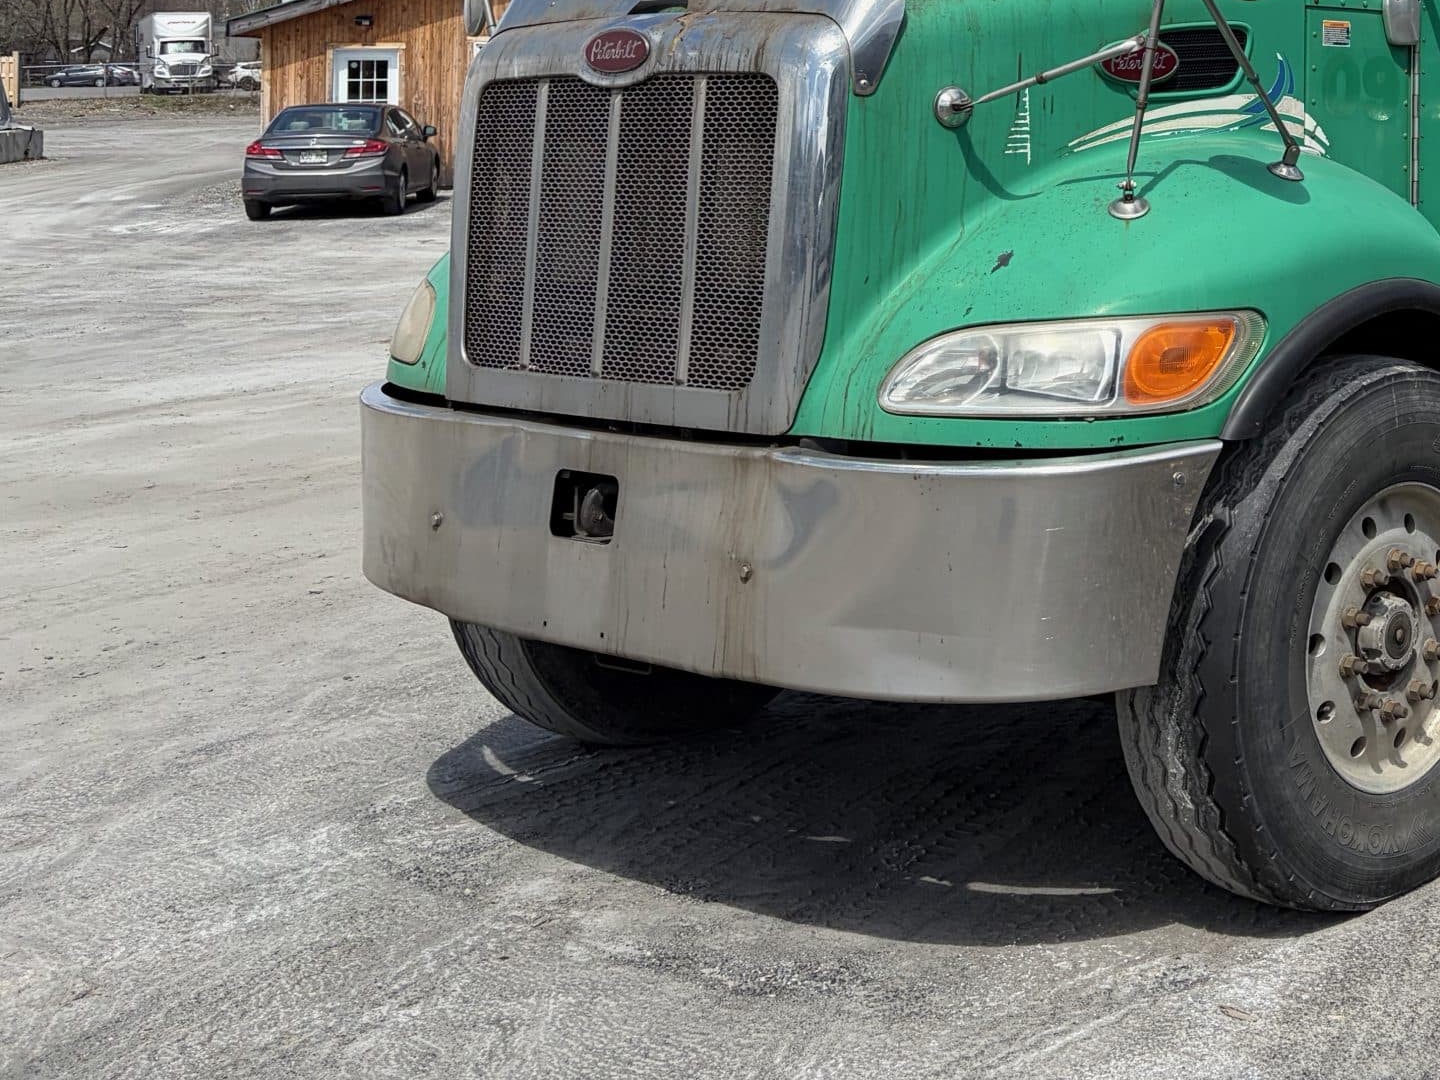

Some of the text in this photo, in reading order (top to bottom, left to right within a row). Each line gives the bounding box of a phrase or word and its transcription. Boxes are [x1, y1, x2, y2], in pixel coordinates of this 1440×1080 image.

[591, 38, 642, 62] Peterbilt
[1111, 51, 1171, 73] Peterlt
[1287, 736, 1402, 856] YOKOHAMA
